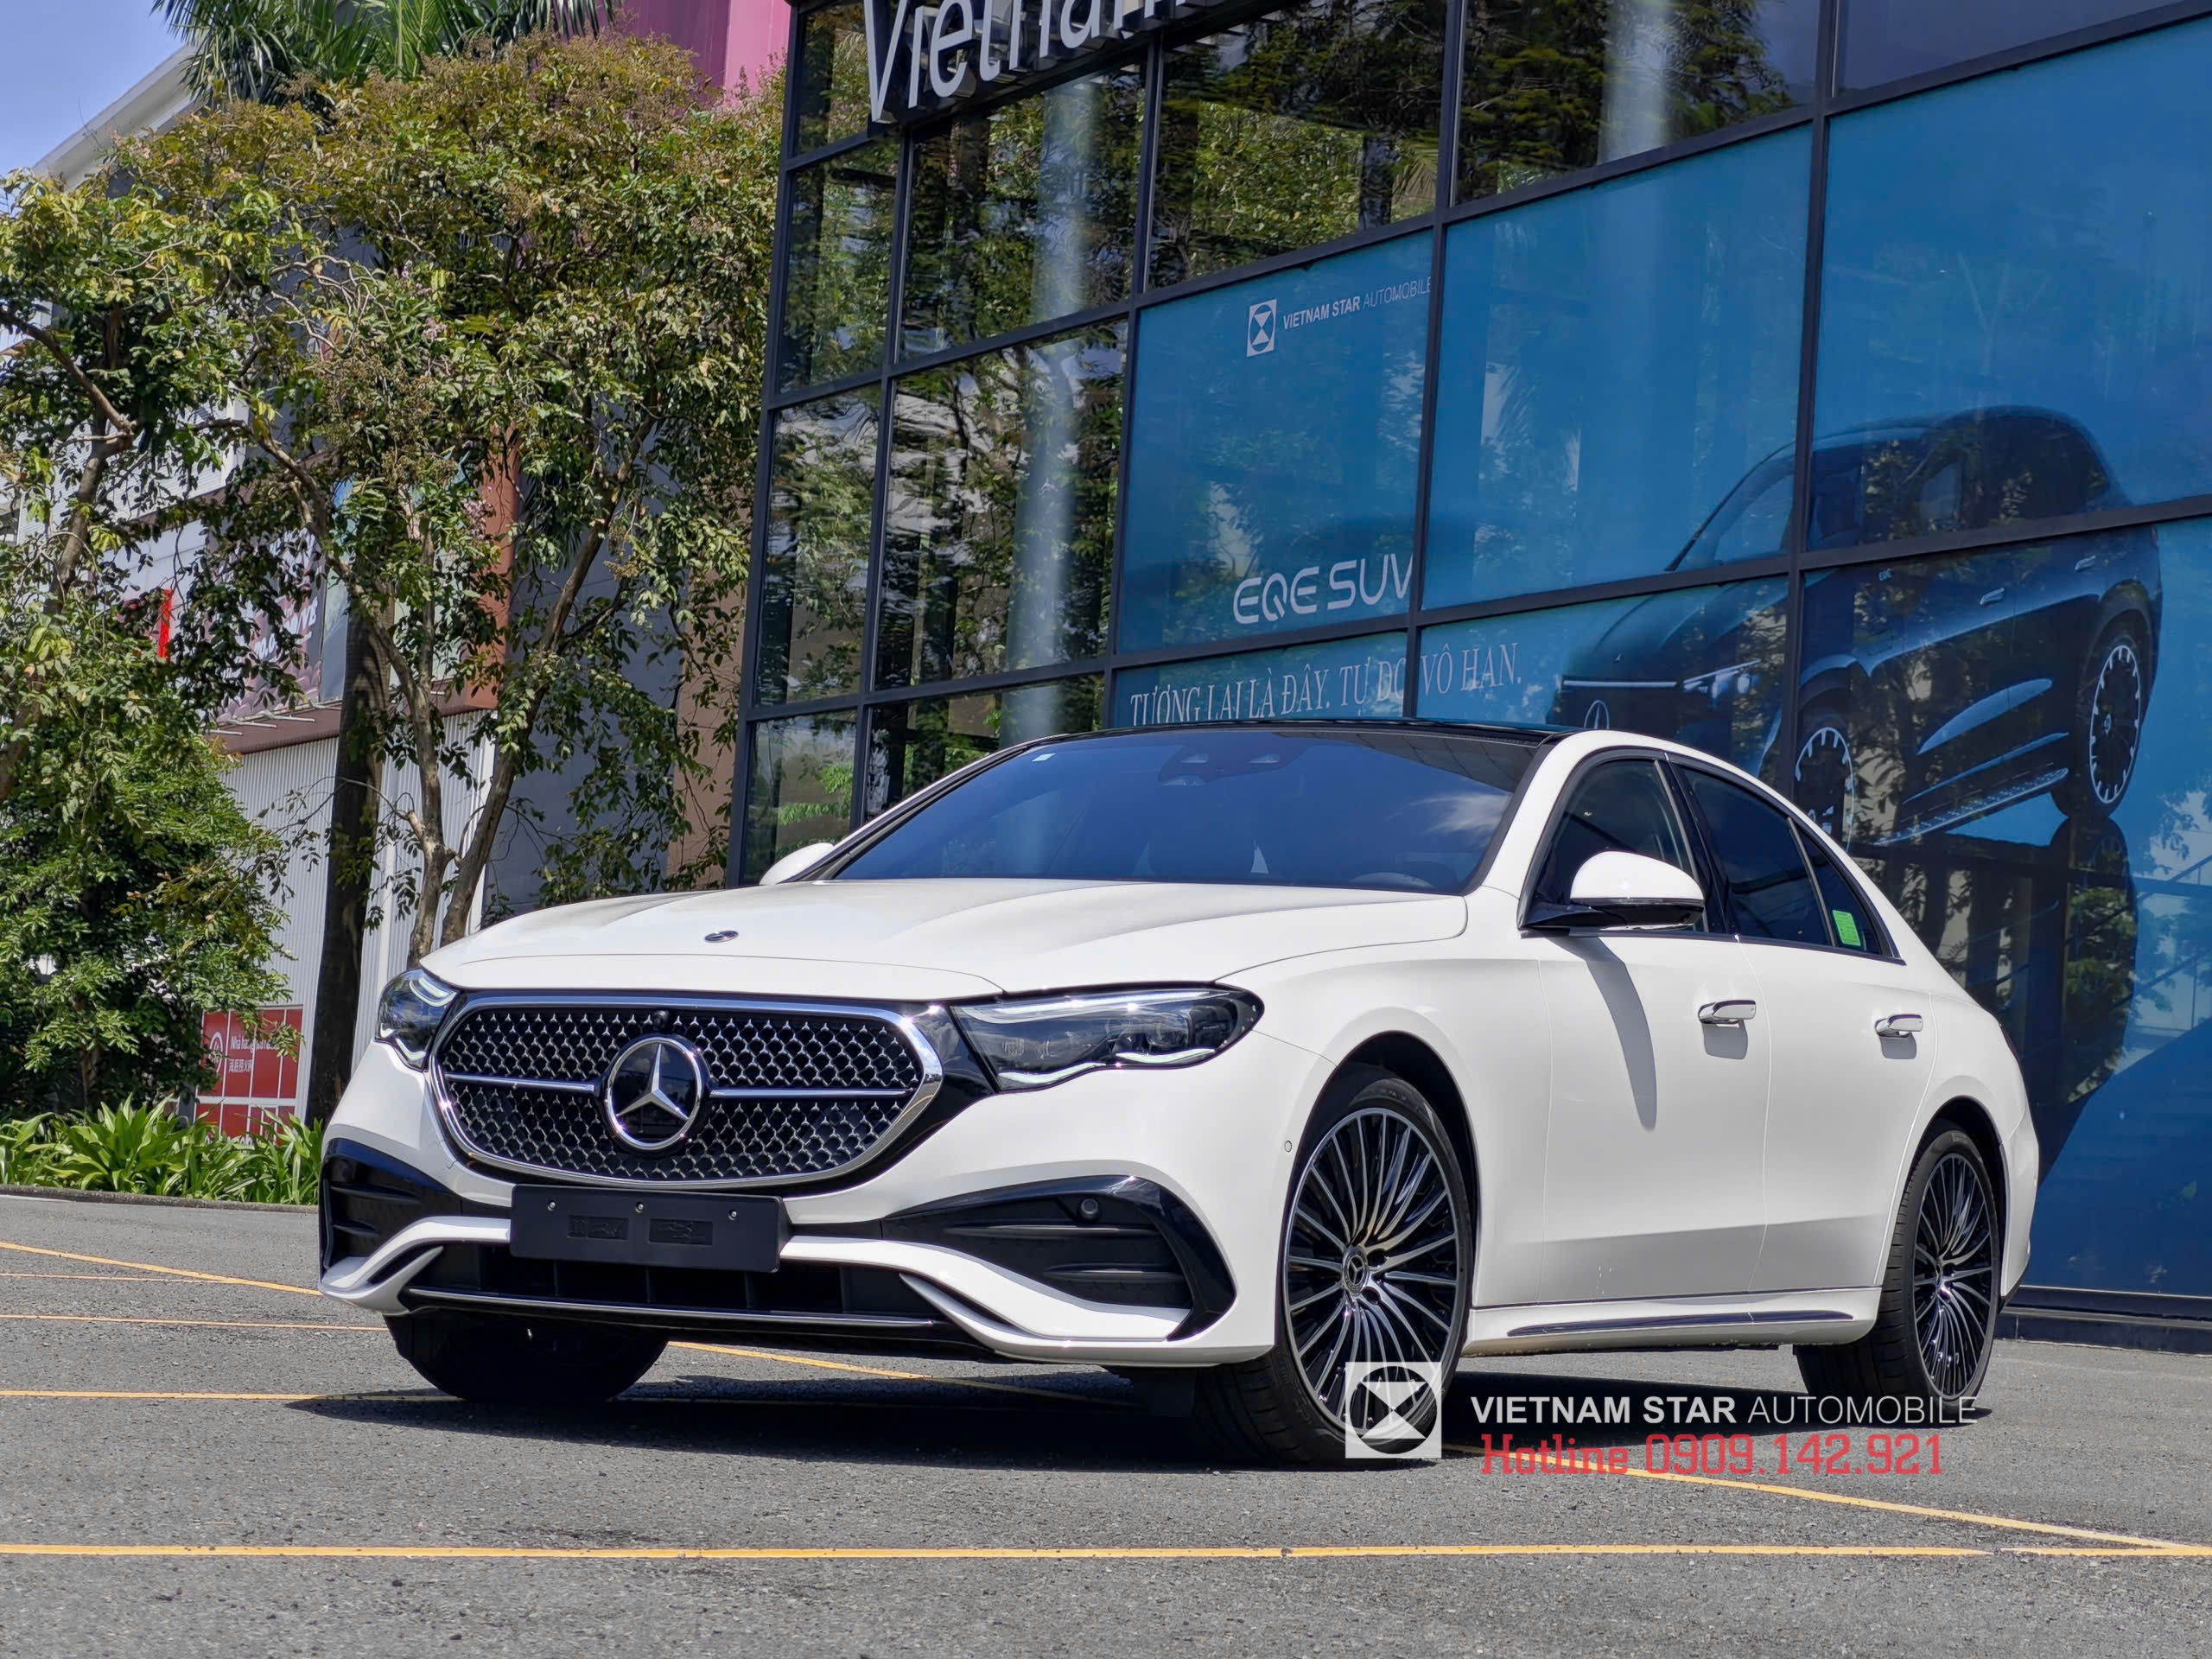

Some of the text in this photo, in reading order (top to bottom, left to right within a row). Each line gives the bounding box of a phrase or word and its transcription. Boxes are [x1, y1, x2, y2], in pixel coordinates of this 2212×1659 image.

[864, 0, 1185, 123] Vietna
[1283, 276, 1432, 330] VIETNAM STAR AUTOMOBILE
[1232, 553, 1413, 624] EQE SUV
[1249, 667, 1275, 718] LÀ
[1281, 663, 1331, 715] ĐÂY.
[1421, 642, 1453, 696] VÔ
[1460, 642, 1522, 699] HẠN.
